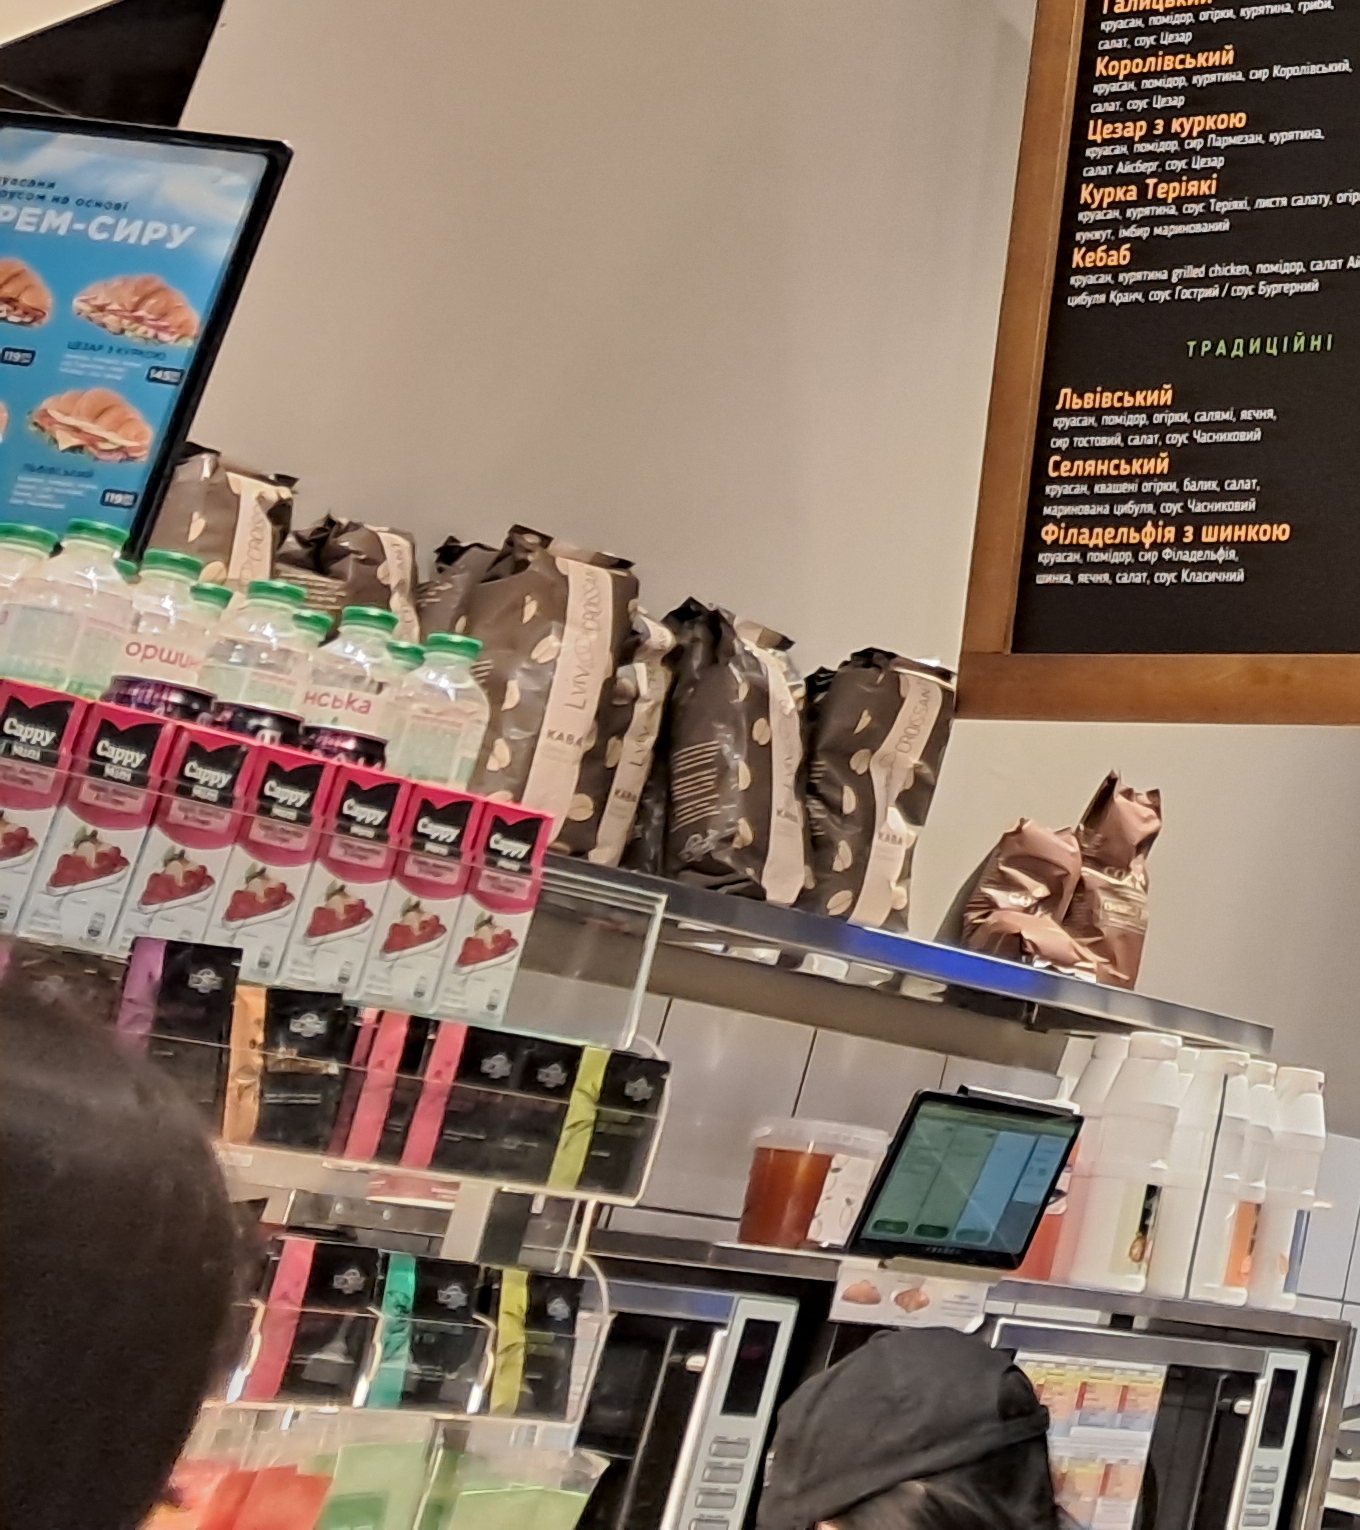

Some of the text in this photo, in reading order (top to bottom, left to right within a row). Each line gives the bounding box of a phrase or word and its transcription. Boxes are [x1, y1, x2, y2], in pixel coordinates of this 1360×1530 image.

[1095, 44, 1235, 81] Королівський
[1087, 118, 1148, 144] Цезар
[1170, 112, 1247, 138] куркою
[1079, 173, 1218, 209] Курка Теріякі
[1071, 242, 1131, 269] Кебаб
[1186, 333, 1333, 358] ТРАДИЦІЙНІ
[1055, 383, 1173, 413] Львівський
[1047, 451, 1170, 482] Селянський
[1042, 497, 1257, 519] маринована цибуля, соус Часниковий
[1040, 520, 1176, 550] Філадельфія
[1201, 523, 1291, 550] шинкою
[3, 717, 56, 747] Cappy
[96, 740, 147, 768] Cappy
[184, 761, 233, 788] Cappy
[264, 780, 310, 808] Cappy
[342, 799, 388, 825] Cappy
[417, 817, 461, 843] Cappy
